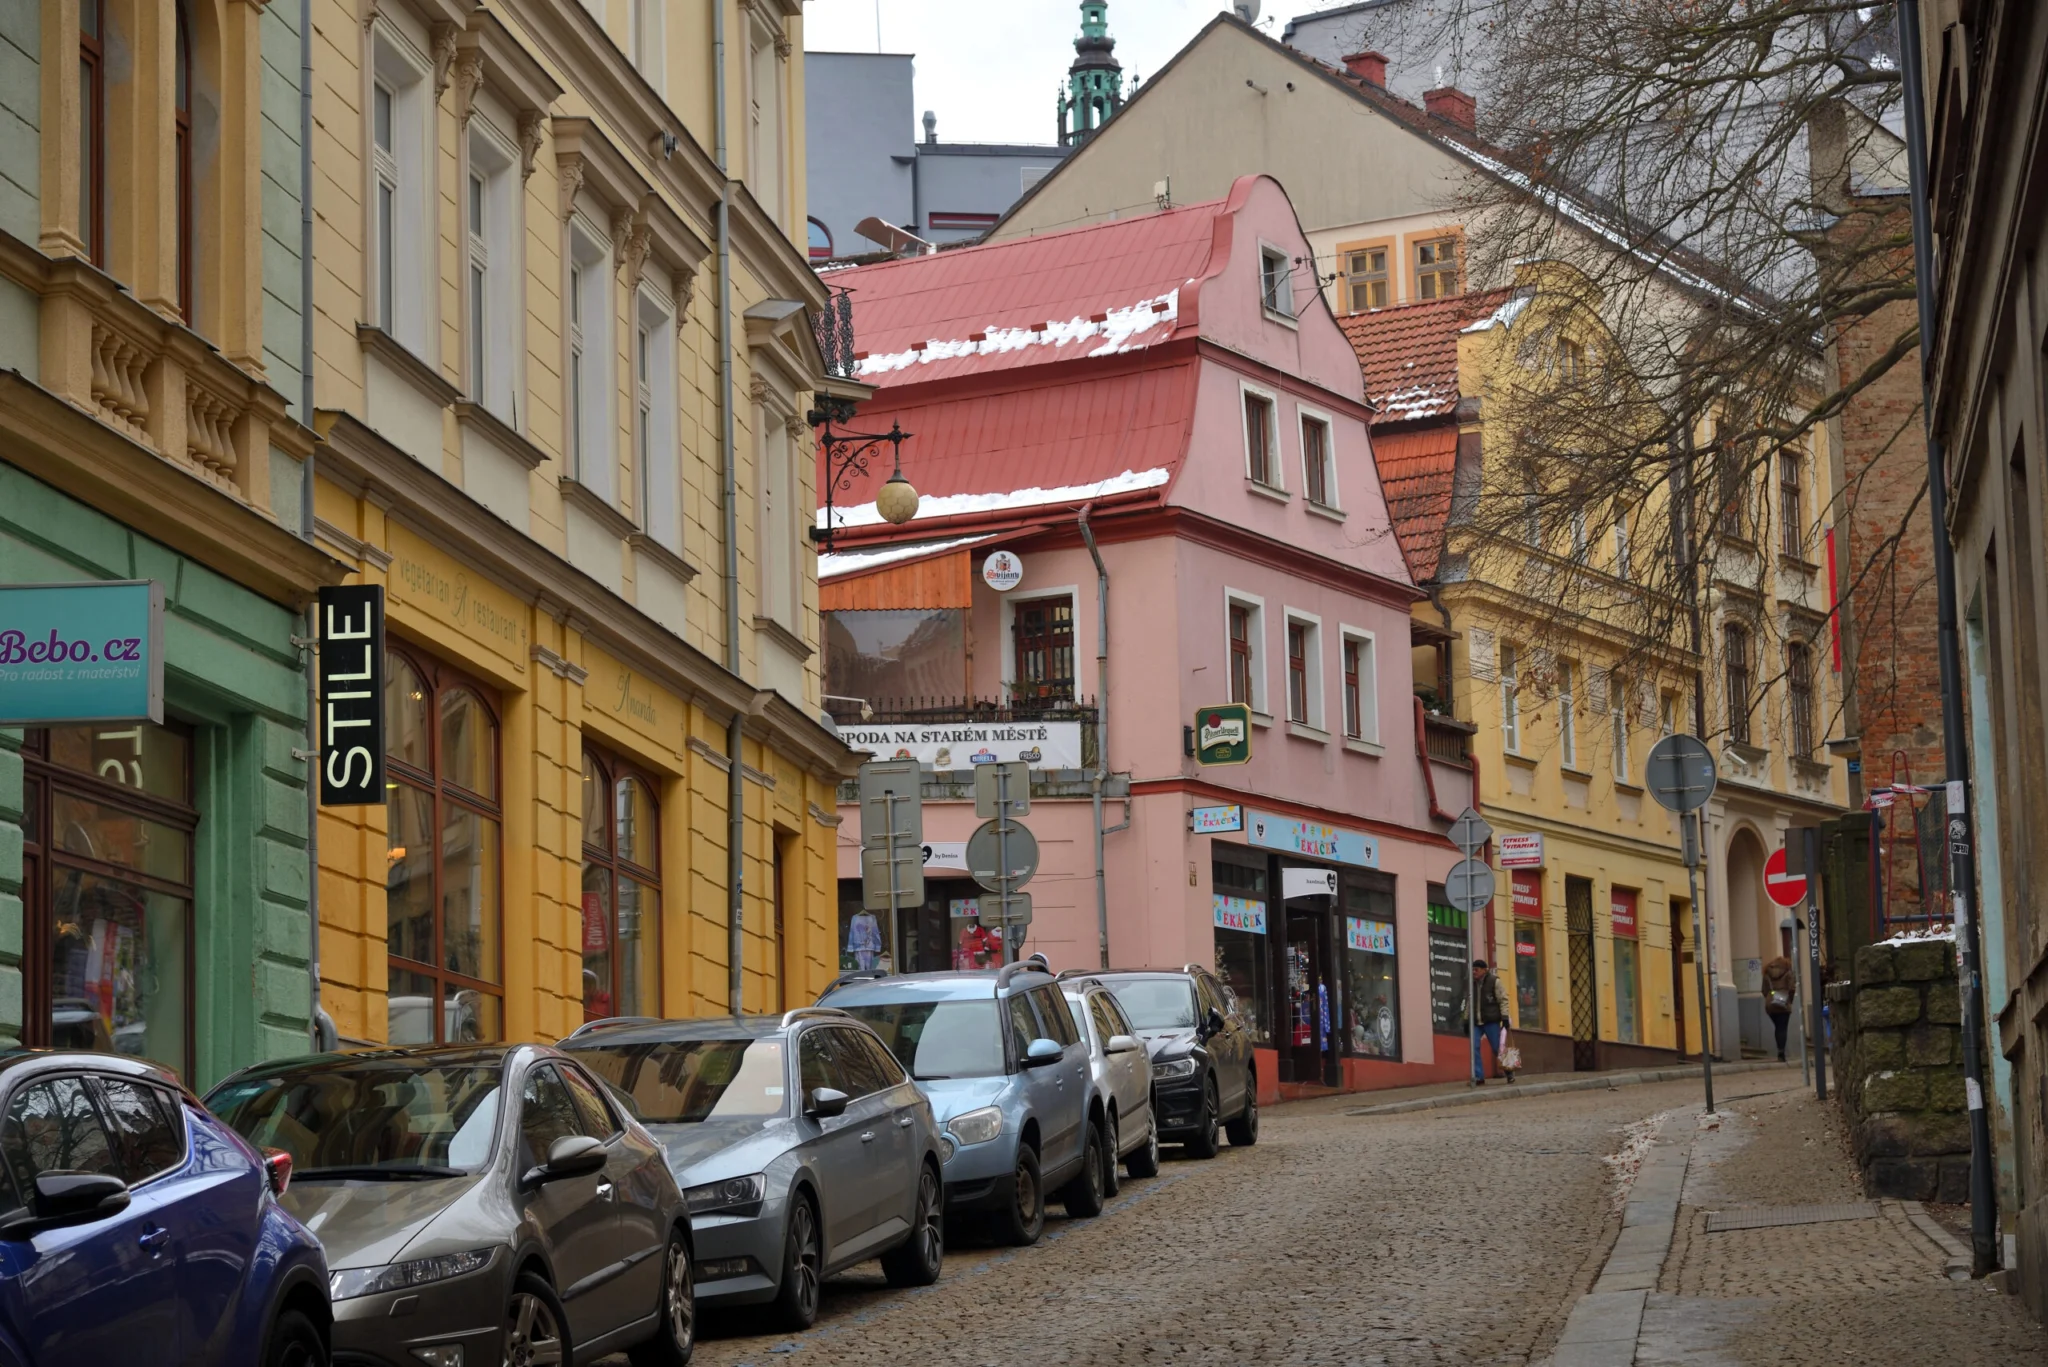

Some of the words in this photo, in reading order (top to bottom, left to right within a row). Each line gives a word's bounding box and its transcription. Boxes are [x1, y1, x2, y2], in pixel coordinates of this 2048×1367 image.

[400, 556, 450, 604] vegetarian
[473, 598, 517, 645] restaurant
[0, 669, 18, 681] Pro
[22, 667, 63, 681] radost
[66, 669, 74, 680] z
[77, 665, 141, 679] mateřství
[327, 601, 373, 788] STILE
[895, 731, 917, 743] NA
[921, 727, 988, 743] STARÉM
[992, 725, 1048, 741] MĚSTĚ
[972, 755, 995, 763] BIRELL
[1020, 752, 1040, 760] FRISCO
